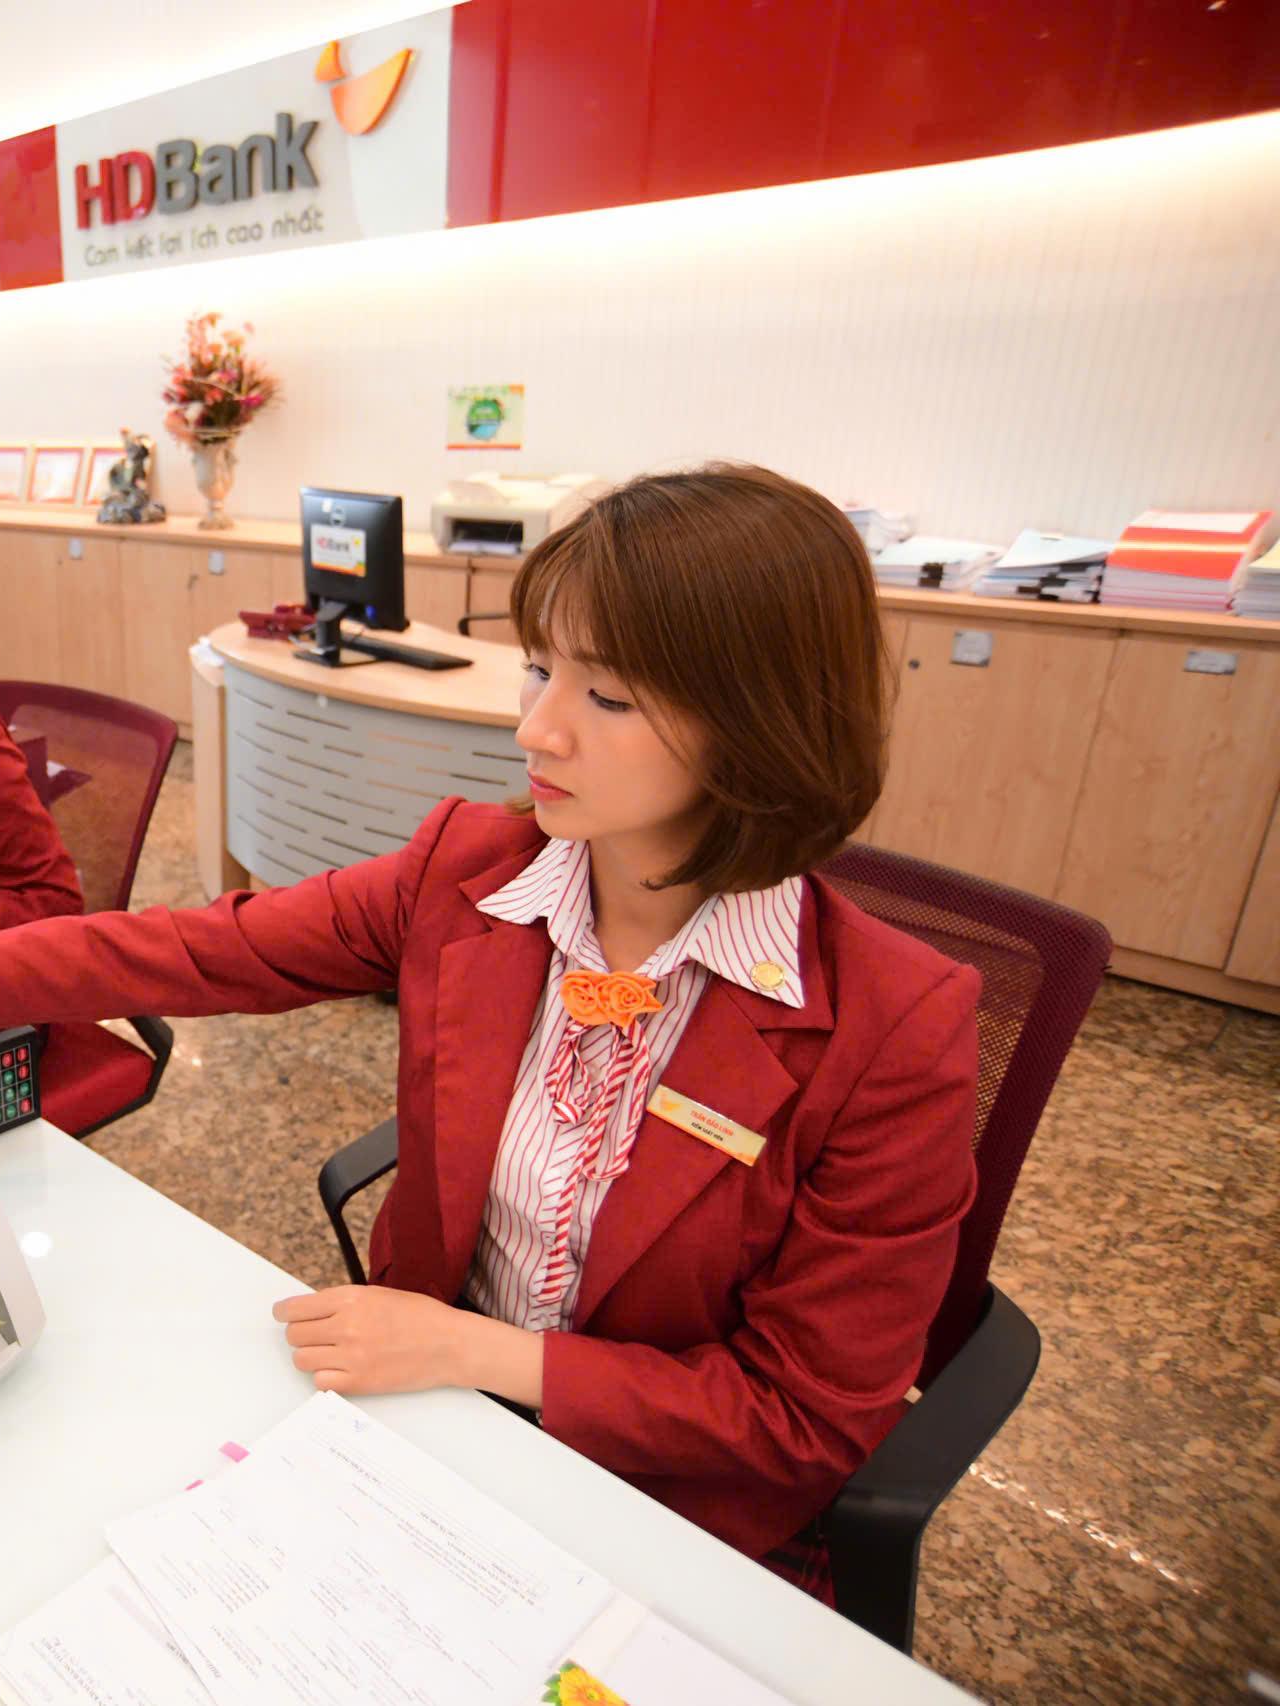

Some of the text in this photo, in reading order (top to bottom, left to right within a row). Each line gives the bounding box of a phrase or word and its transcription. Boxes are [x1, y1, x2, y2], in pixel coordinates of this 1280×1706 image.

[75, 112, 320, 229] HDBank
[226, 222, 263, 244] cao
[272, 204, 324, 238] nhất
